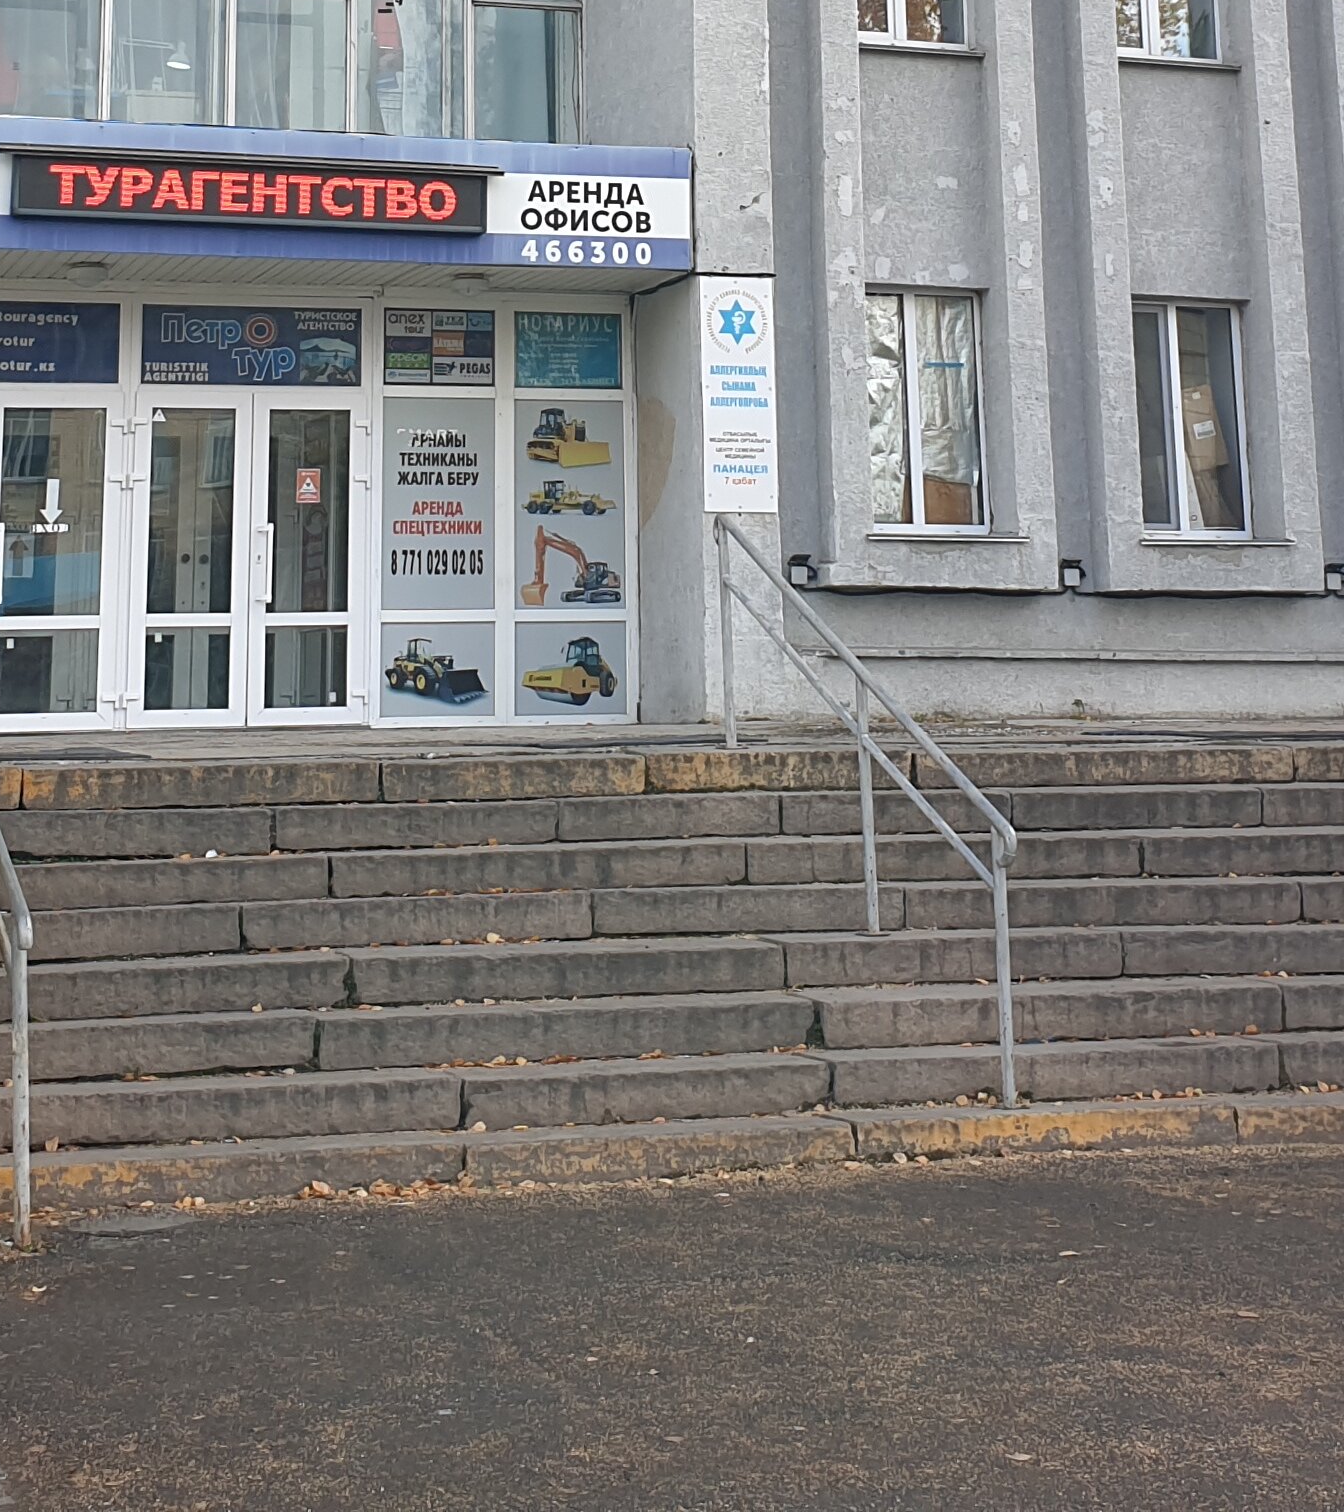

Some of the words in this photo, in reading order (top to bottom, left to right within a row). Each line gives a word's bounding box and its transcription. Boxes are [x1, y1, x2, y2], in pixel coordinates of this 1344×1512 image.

[50, 164, 457, 221] ТУРАГЕНТСТВО
[527, 180, 644, 209] АРЕНДА
[520, 208, 652, 233] ОФИСОВ
[521, 240, 652, 265] 466300
[294, 311, 357, 322] ТУРИСТСКОЕ
[388, 313, 425, 325] anex
[518, 314, 613, 332] НОТАРИУС
[296, 321, 355, 331] АГЕНТСТВО
[144, 362, 209, 372] TURISTTIK
[459, 363, 491, 375] PEGAS
[721, 381, 756, 392] СЫНАМА
[710, 397, 768, 408] АЛЛЕРГОПРОБА
[399, 452, 478, 467] ТЕХНИКАНЫ
[713, 464, 769, 475] ПАНАЦЕЯ
[397, 472, 444, 486] ЖАЛГА
[447, 472, 479, 486] БЕРУ
[724, 476, 730, 485] 7
[412, 501, 464, 517] АРЕНДА
[392, 520, 482, 536] СПЕЦТЕХНИКИ
[391, 549, 398, 576] 8
[402, 549, 422, 576] 771
[427, 549, 448, 576] 029
[452, 549, 466, 576] 02
[470, 549, 484, 576] 05
